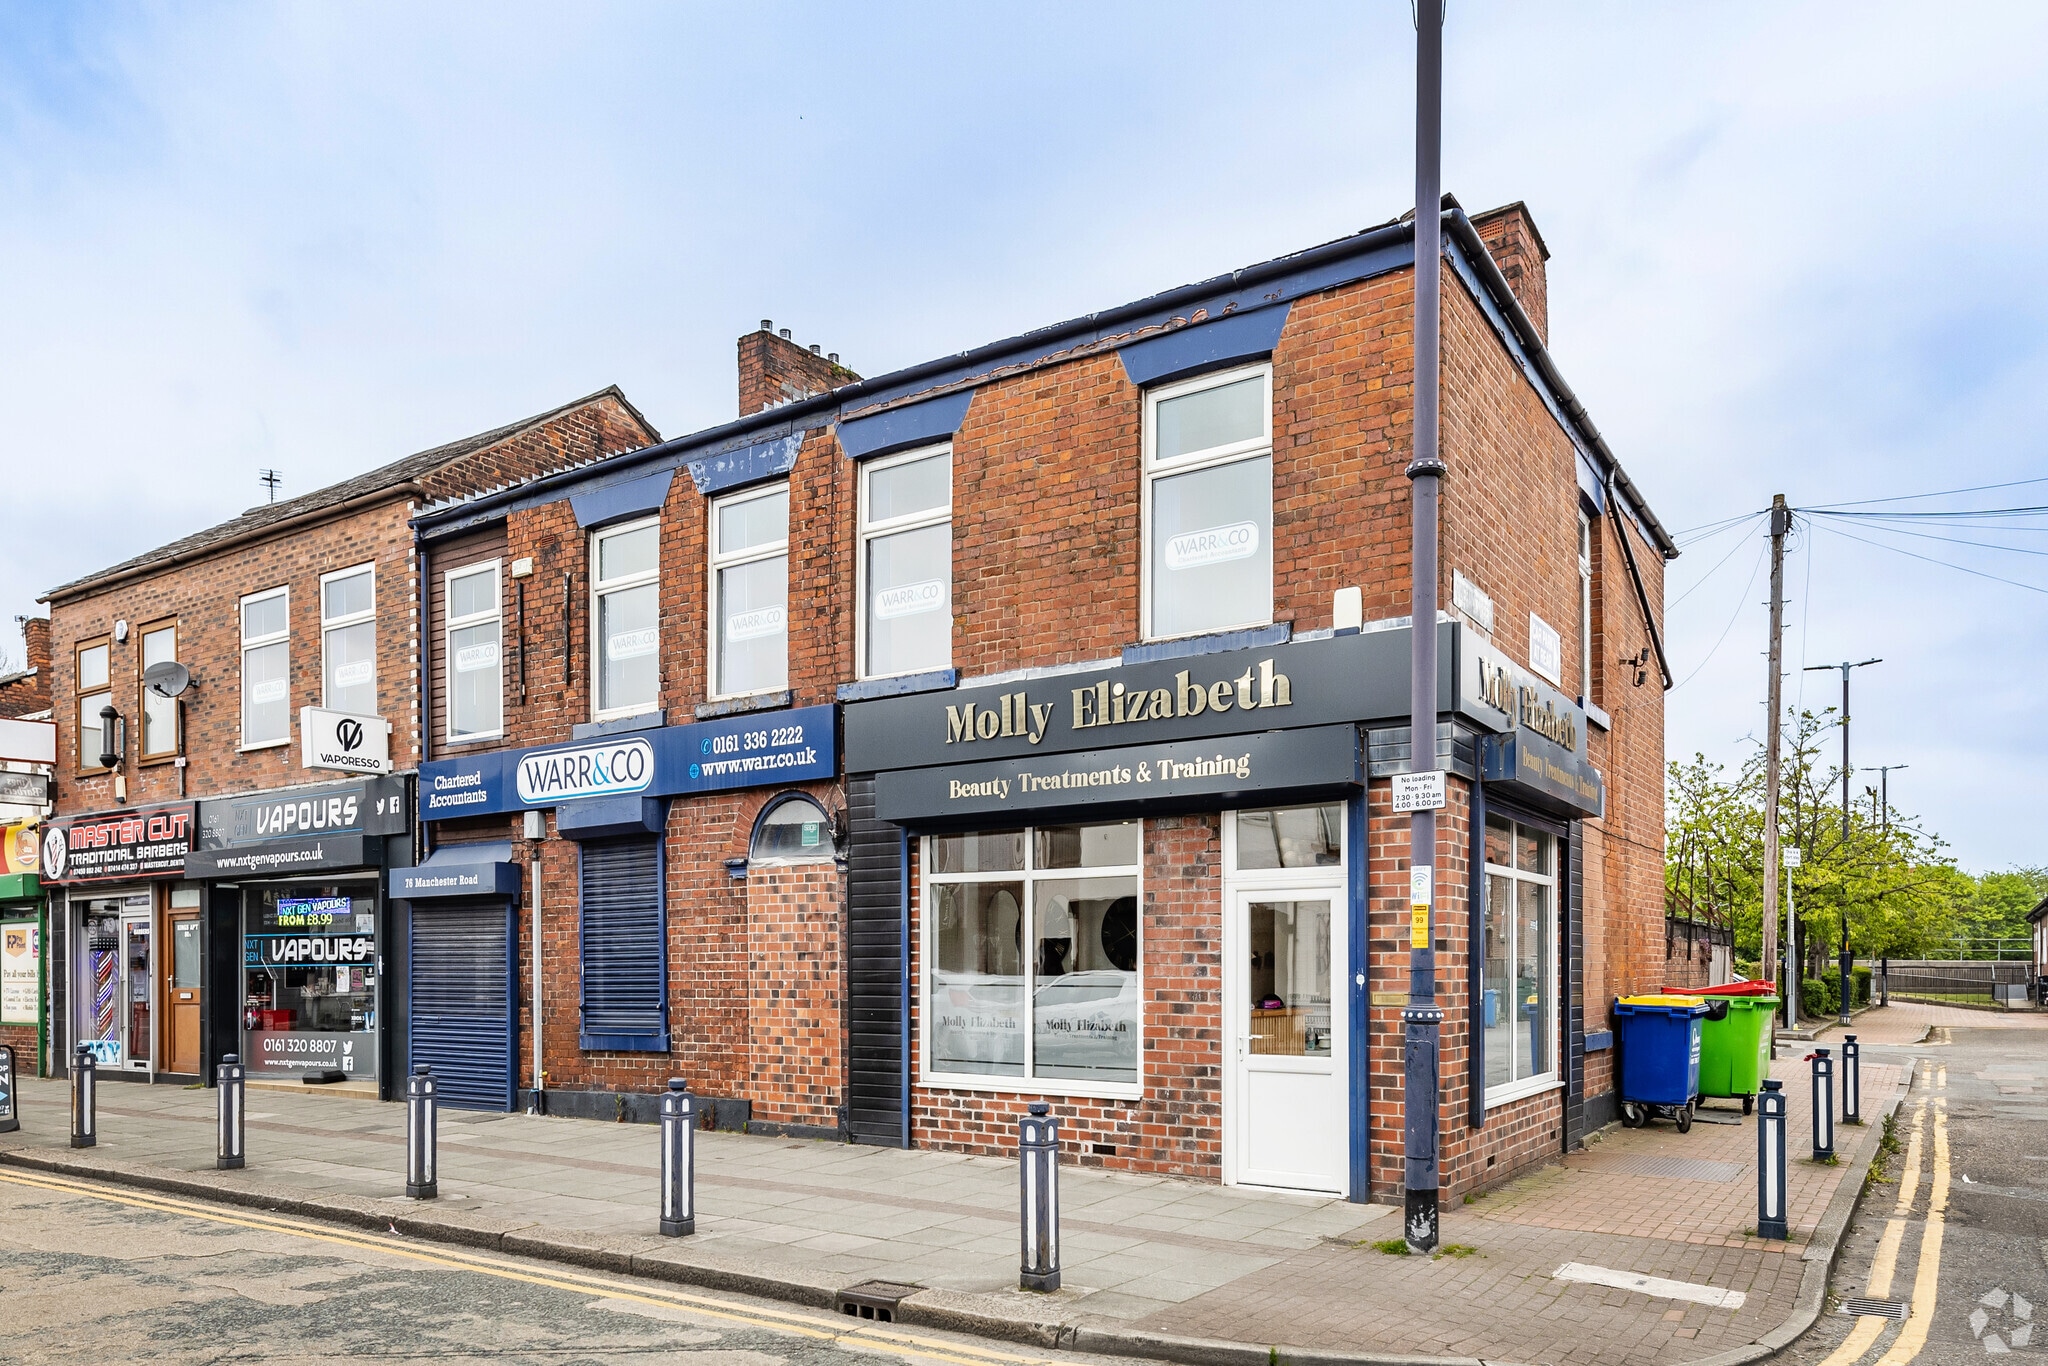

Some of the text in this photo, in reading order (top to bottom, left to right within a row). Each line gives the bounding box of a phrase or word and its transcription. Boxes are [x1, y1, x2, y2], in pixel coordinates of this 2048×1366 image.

[1174, 528, 1249, 555] WARR&CO
[882, 585, 938, 607] WARR&CO
[732, 610, 781, 630] WARR&CO
[945, 658, 1292, 745] Molly Elizabeth
[713, 725, 803, 754] 0161 336 2222
[320, 752, 381, 769] VAPORESSO
[525, 747, 645, 793] WARR&CO
[701, 747, 817, 777] www.warr.co.uk
[434, 771, 482, 790] Chartered
[949, 752, 1251, 799] Beauty Treatments & Training
[1412, 775, 1436, 783] loading
[429, 789, 487, 809] Accountants
[1396, 793, 1411, 801] 7.30
[208, 813, 220, 824] 0161
[256, 795, 359, 835] VAPOURS
[69, 813, 189, 849] MASTER CUT
[202, 828, 225, 839] 320 8807
[69, 842, 189, 866] TRADITIONAL BARBERS
[216, 842, 324, 871] www.nxtgenvapours.co.uk
[405, 874, 478, 888] 76 Manchester Road
[282, 897, 347, 915] NXT GEN VAPOURS
[278, 914, 305, 926] FROM
[306, 913, 333, 926] £8.99
[1415, 916, 1424, 924] 99
[244, 940, 258, 949] NXT
[271, 938, 367, 961] VAPOURS
[244, 952, 259, 962] GEN
[263, 1038, 337, 1053] 0161 320 8807
[264, 1058, 338, 1069] www.nxtgenvapours.co.uk
